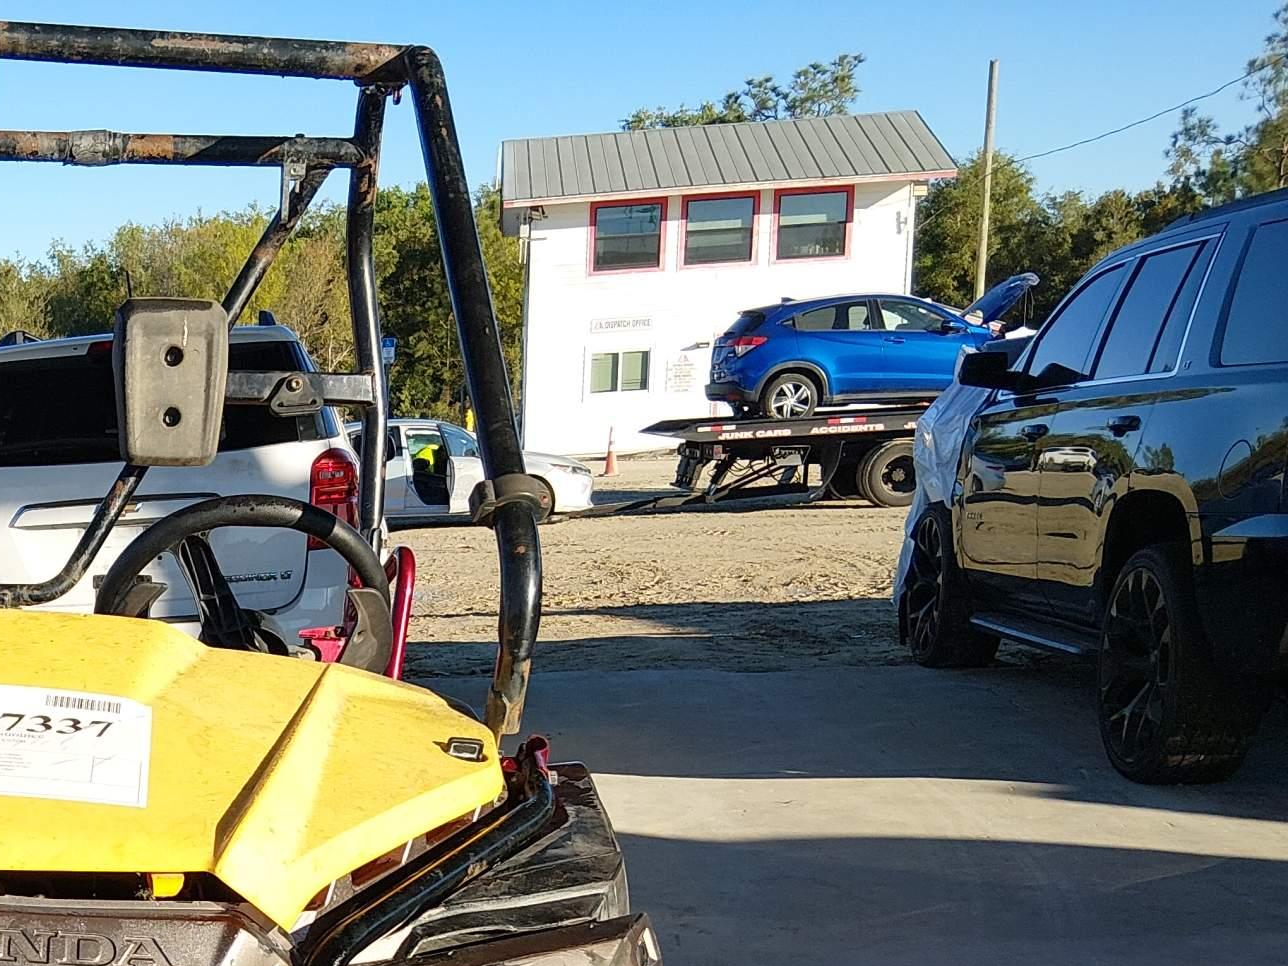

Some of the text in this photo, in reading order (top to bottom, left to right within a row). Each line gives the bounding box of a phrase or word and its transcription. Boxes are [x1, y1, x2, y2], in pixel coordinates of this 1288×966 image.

[632, 318, 652, 328] OFFICE
[718, 428, 792, 440] JUNK CARS
[810, 423, 886, 434] ACCIDENTS
